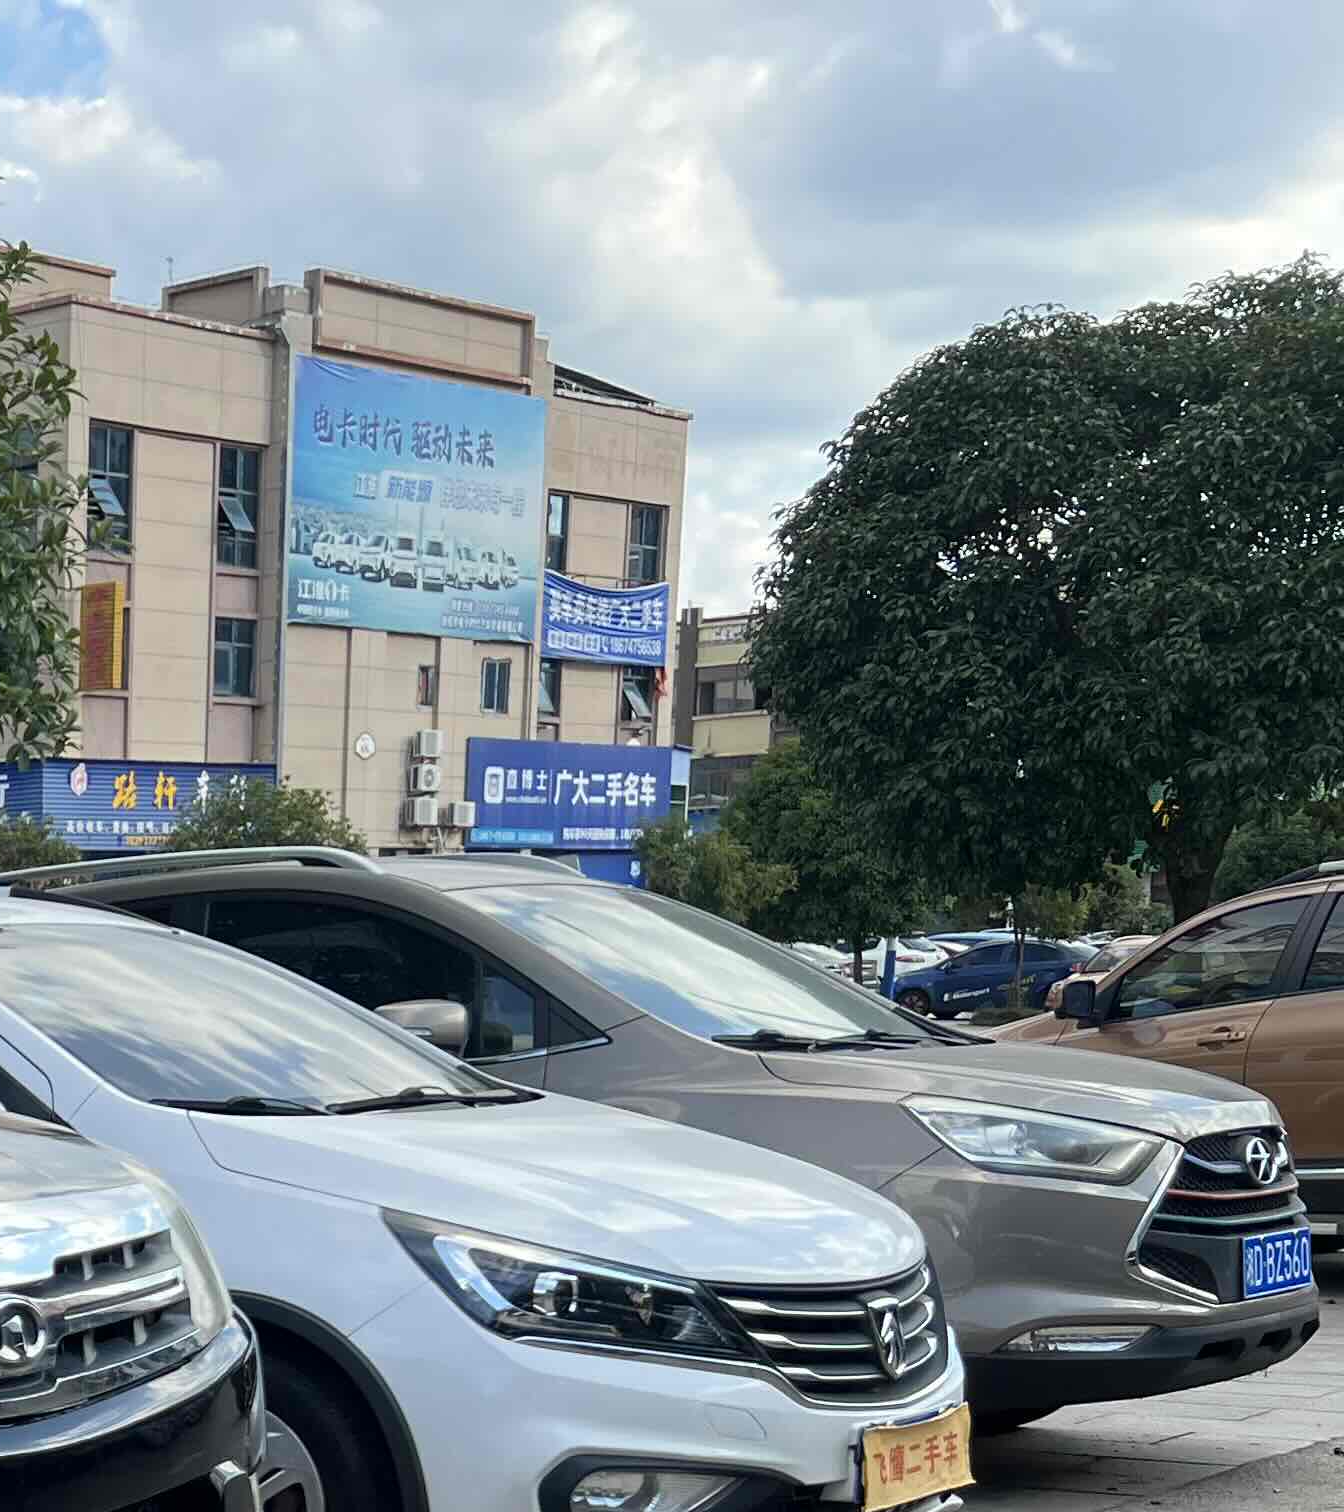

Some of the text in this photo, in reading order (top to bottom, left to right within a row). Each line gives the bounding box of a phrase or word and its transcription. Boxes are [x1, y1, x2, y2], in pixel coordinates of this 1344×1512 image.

[411, 420, 495, 468] 驱动未来
[553, 768, 657, 807] 广大二手名车
